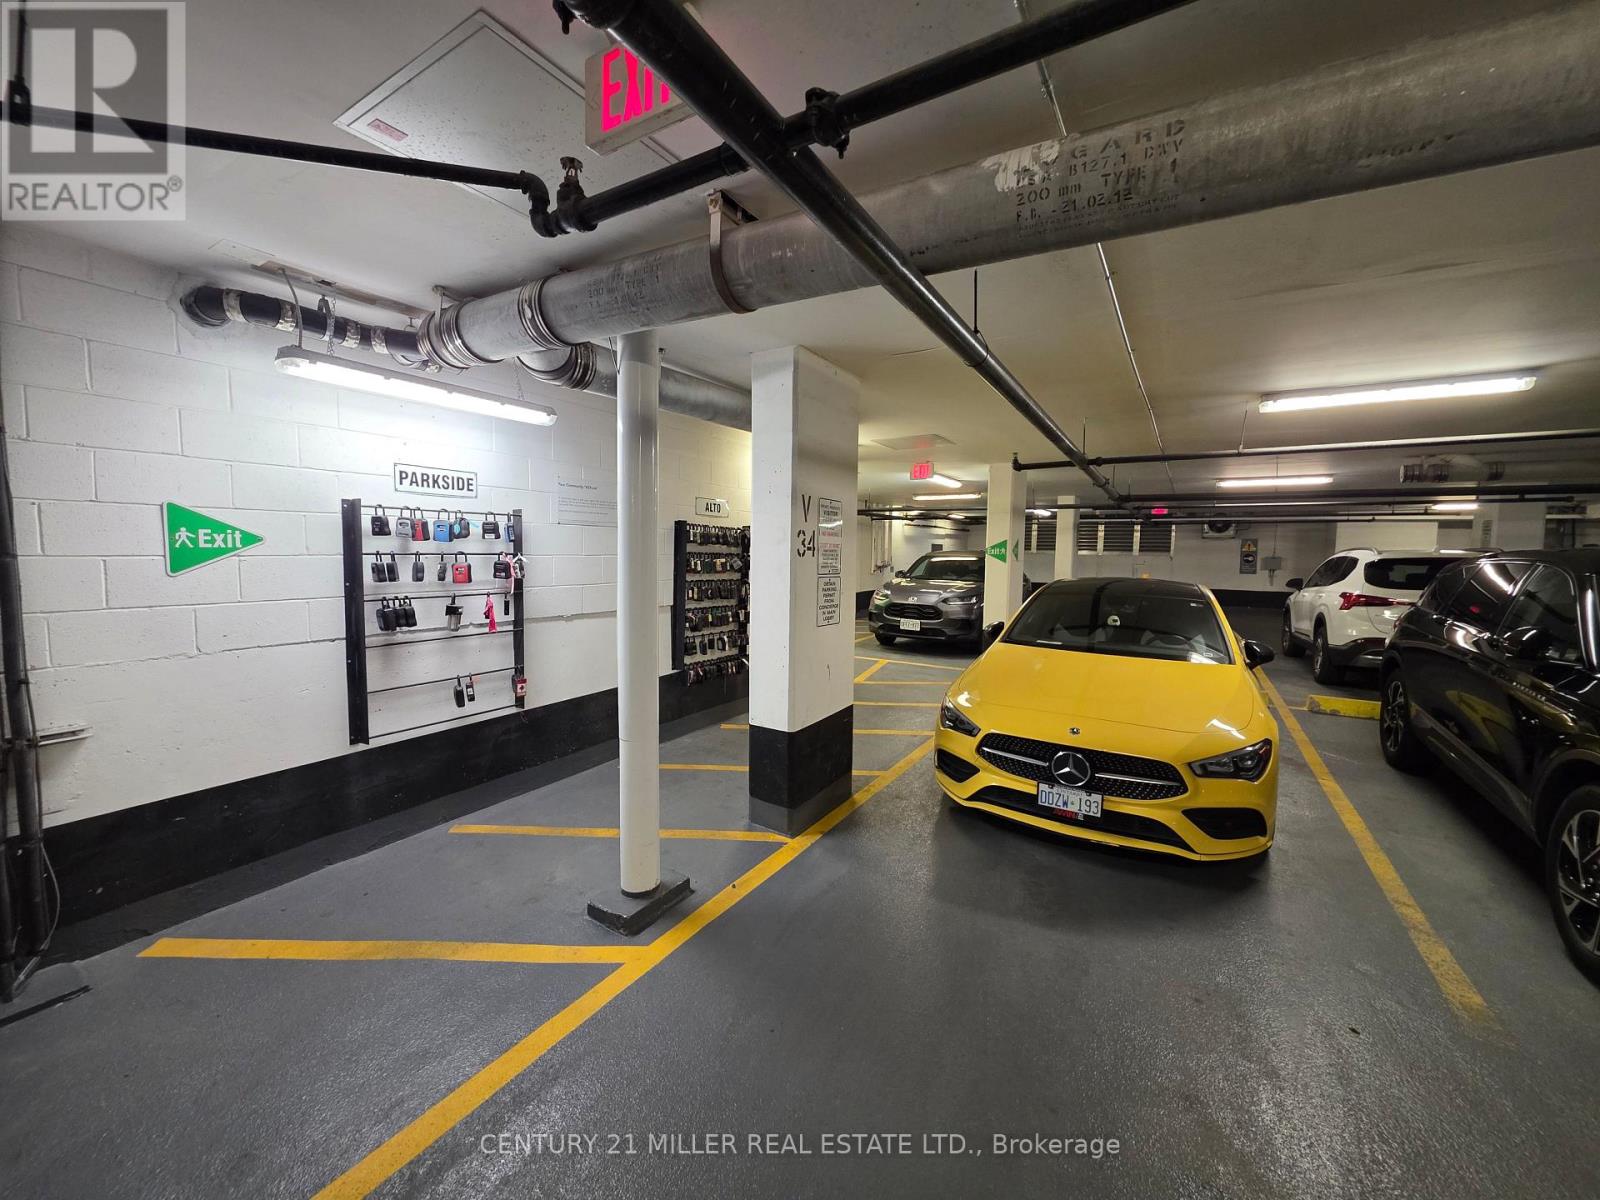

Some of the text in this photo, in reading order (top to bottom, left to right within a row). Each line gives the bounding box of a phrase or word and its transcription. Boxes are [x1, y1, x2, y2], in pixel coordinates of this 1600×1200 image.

[602, 47, 671, 132] EXI
[399, 470, 475, 492] PARKSIDE
[705, 502, 721, 513] ALTO
[802, 494, 811, 522] V
[198, 528, 242, 549] Exit
[797, 529, 815, 558] 34
[1040, 789, 1069, 809] DDZW
[1078, 797, 1099, 815] 193
